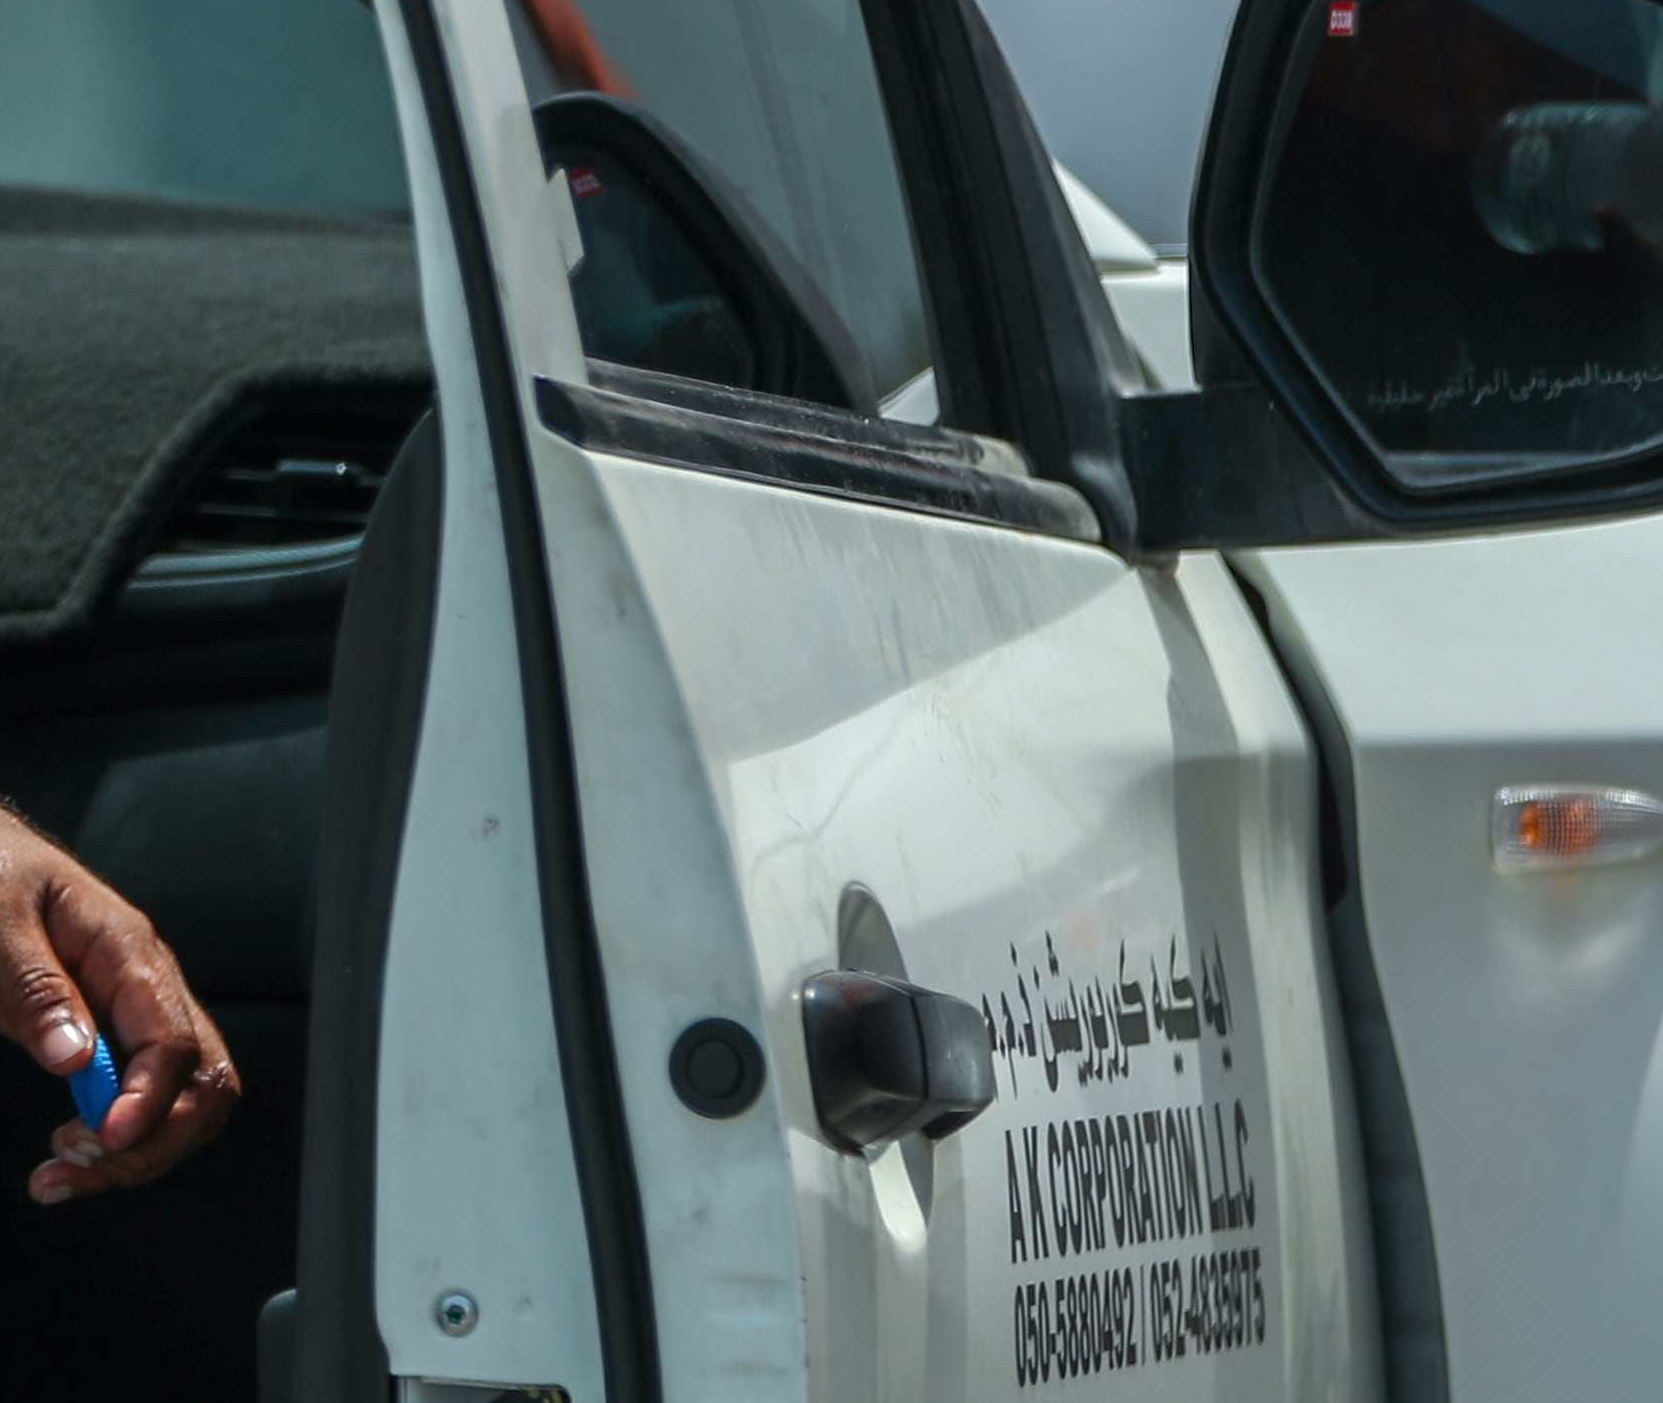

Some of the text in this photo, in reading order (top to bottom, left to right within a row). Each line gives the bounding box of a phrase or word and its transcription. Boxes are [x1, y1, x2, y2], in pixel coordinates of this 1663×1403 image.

[1005, 1129, 1027, 1264] A
[1022, 1125, 1049, 1261] K
[1047, 1106, 1203, 1258] CORPORATION
[1014, 1266, 1137, 1388] 050-5880492
